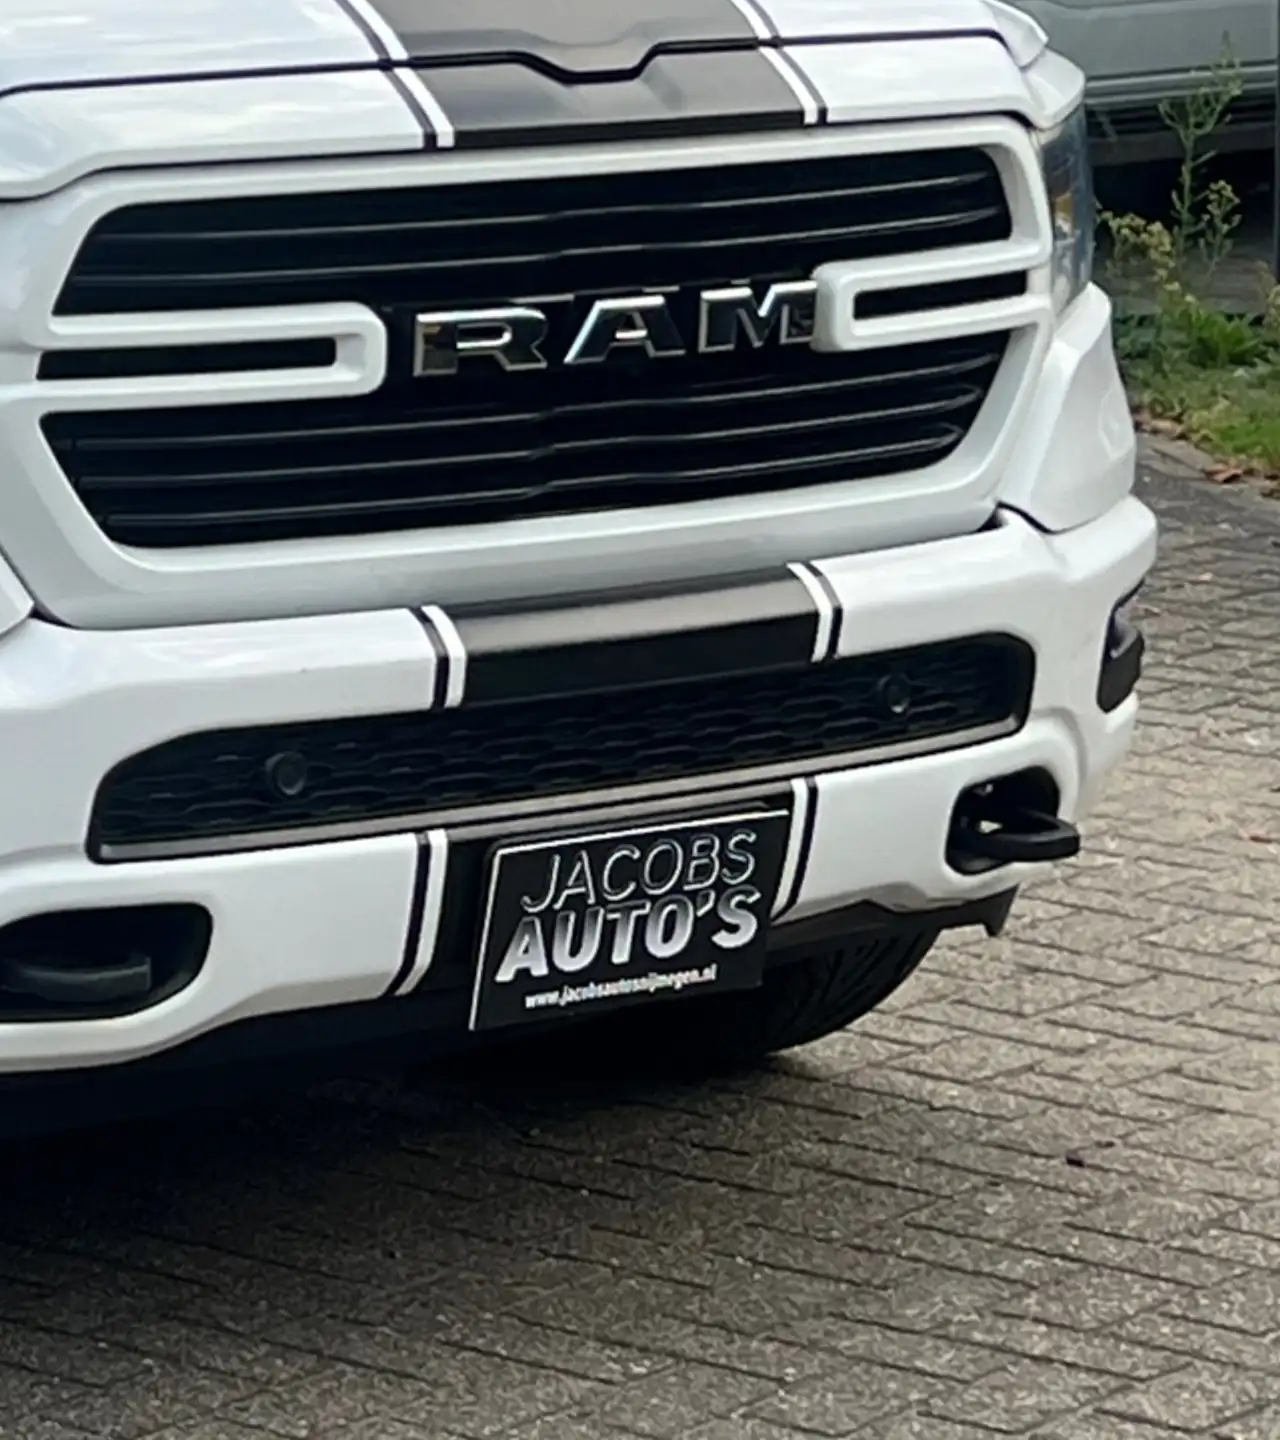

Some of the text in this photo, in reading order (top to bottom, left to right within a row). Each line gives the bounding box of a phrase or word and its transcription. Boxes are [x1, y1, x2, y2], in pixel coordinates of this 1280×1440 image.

[413, 279, 818, 378] RAM
[520, 828, 758, 914] JACOBS
[495, 884, 763, 984] AUTO'S
